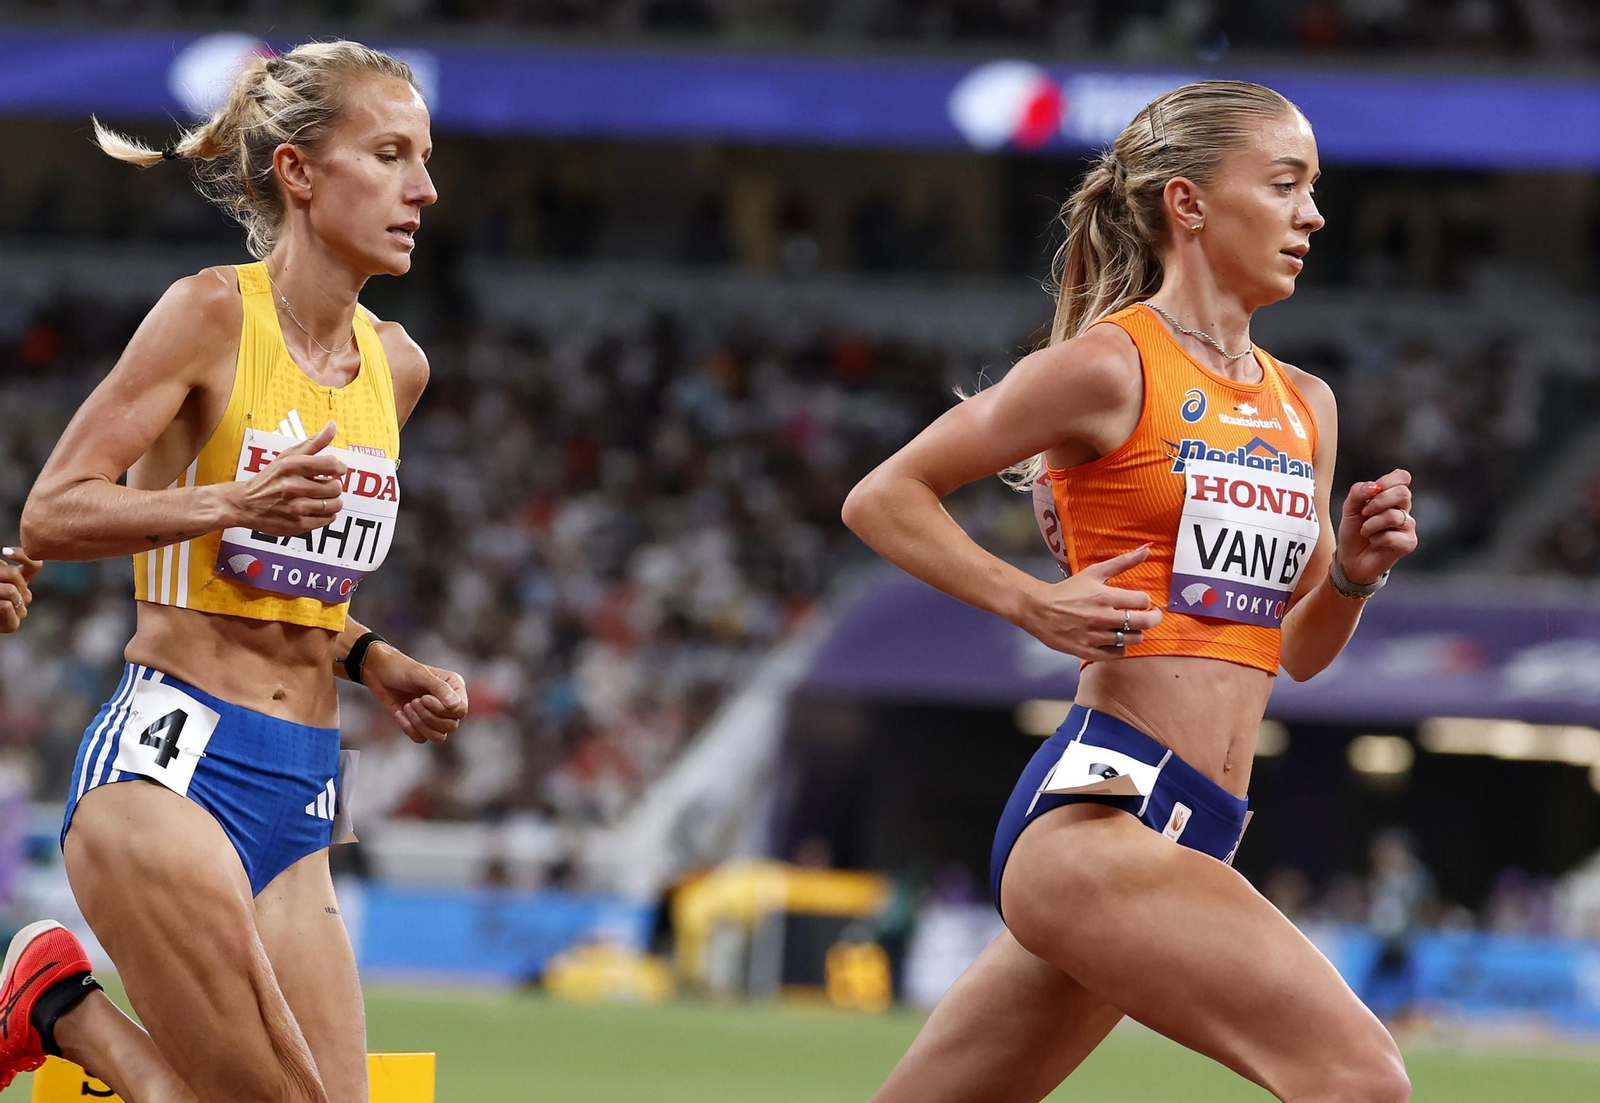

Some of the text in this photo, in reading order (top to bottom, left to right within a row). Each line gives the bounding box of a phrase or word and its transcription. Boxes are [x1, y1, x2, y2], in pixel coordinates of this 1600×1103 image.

[348, 445, 385, 457] BAUHAUS
[1193, 523, 1307, 585] VAN ES
[271, 564, 353, 596] TOKYO
[1225, 590, 1284, 620] TOKYO
[139, 708, 188, 769] 4
